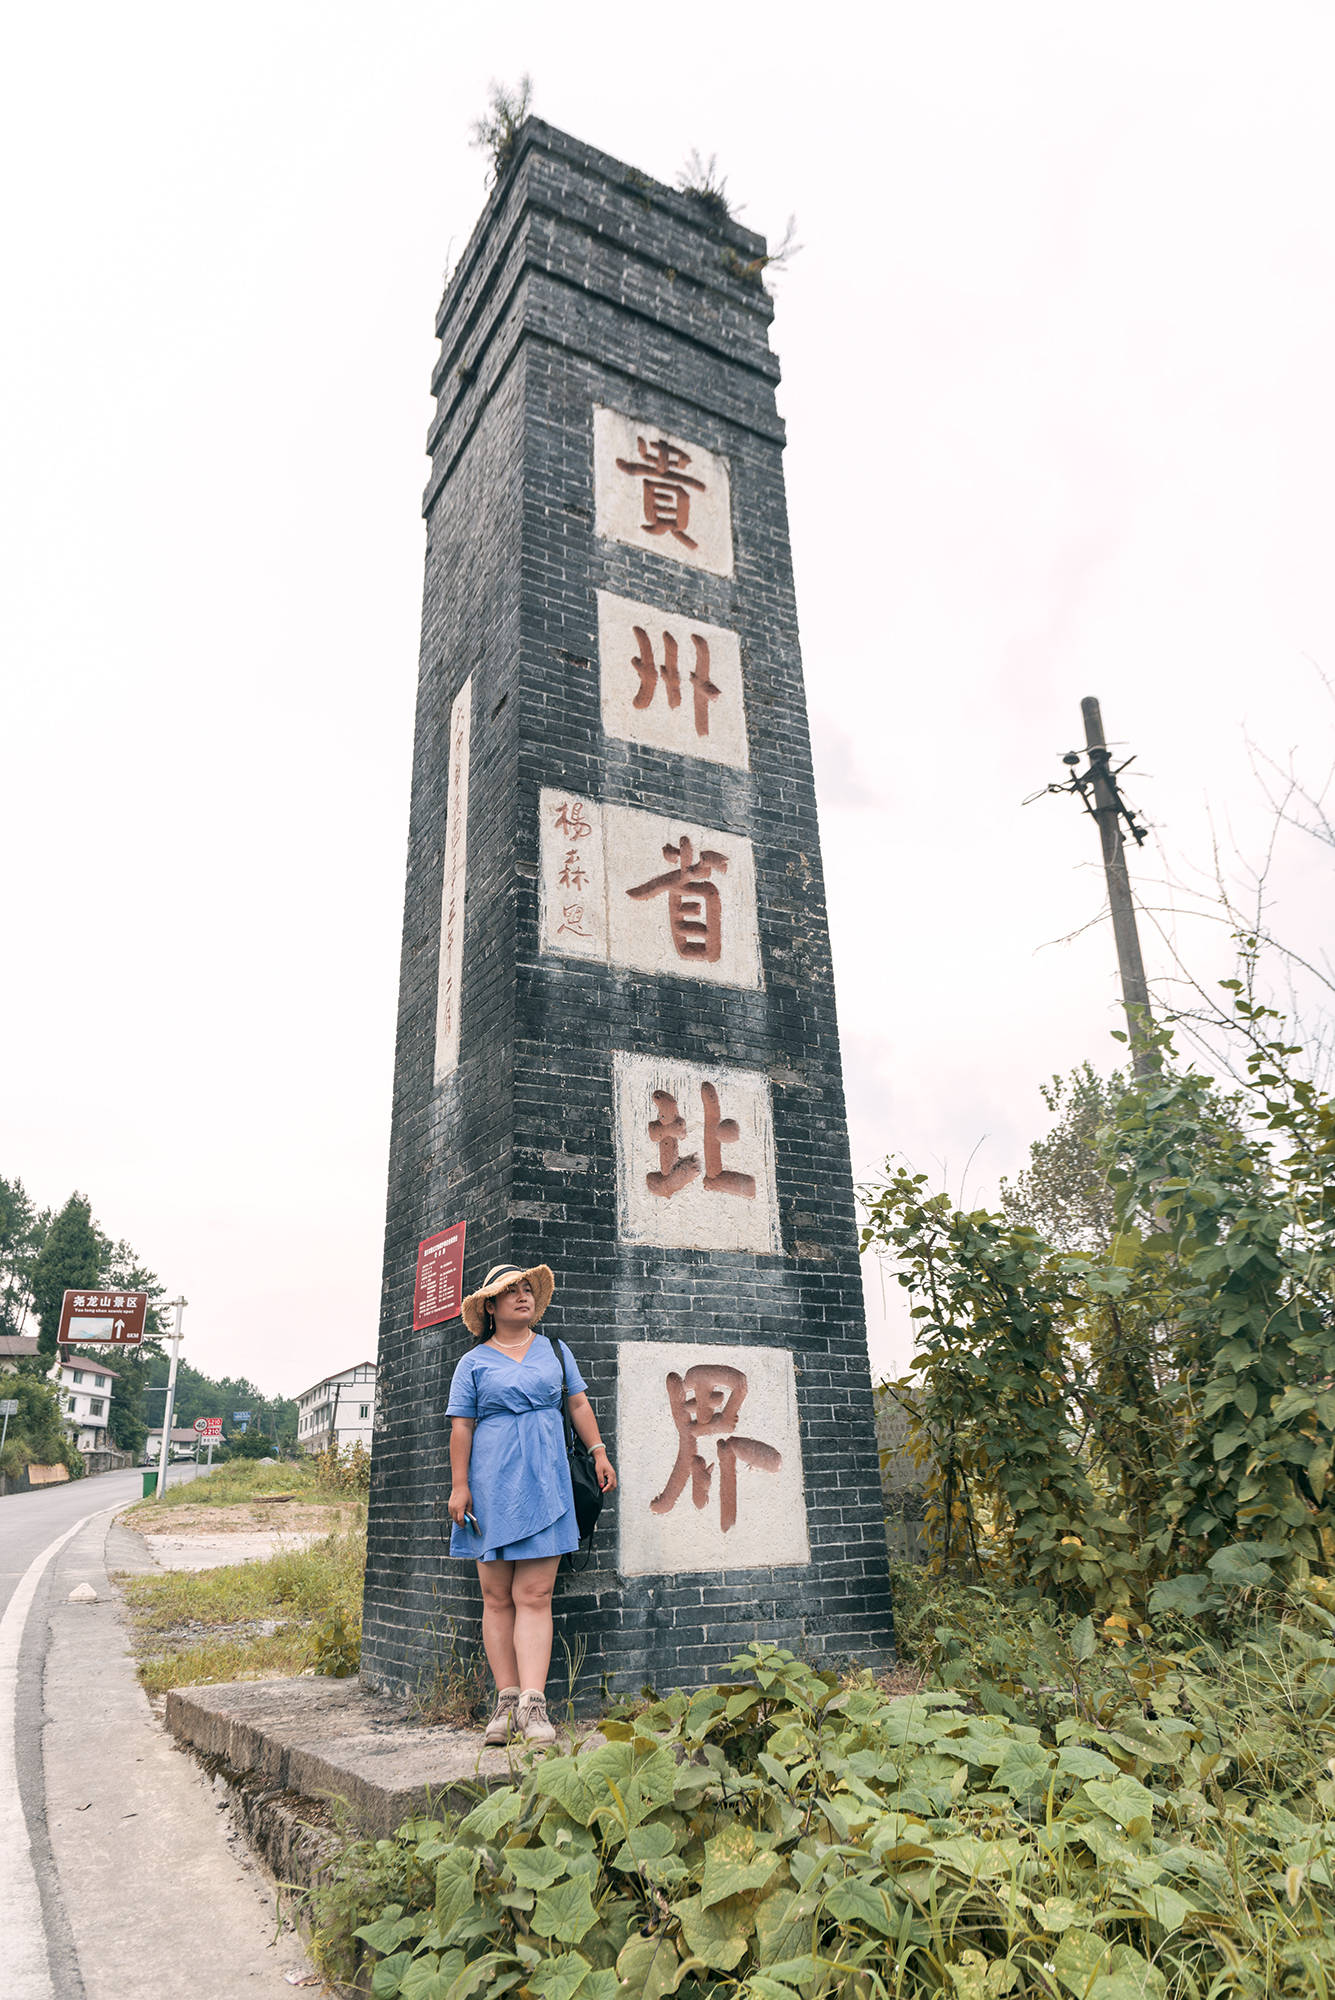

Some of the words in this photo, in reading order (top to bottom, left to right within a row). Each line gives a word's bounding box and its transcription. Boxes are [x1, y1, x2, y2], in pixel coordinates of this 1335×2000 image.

[73, 1295, 138, 1308] 尧龙山景区
[196, 1421, 206, 1429] 40
